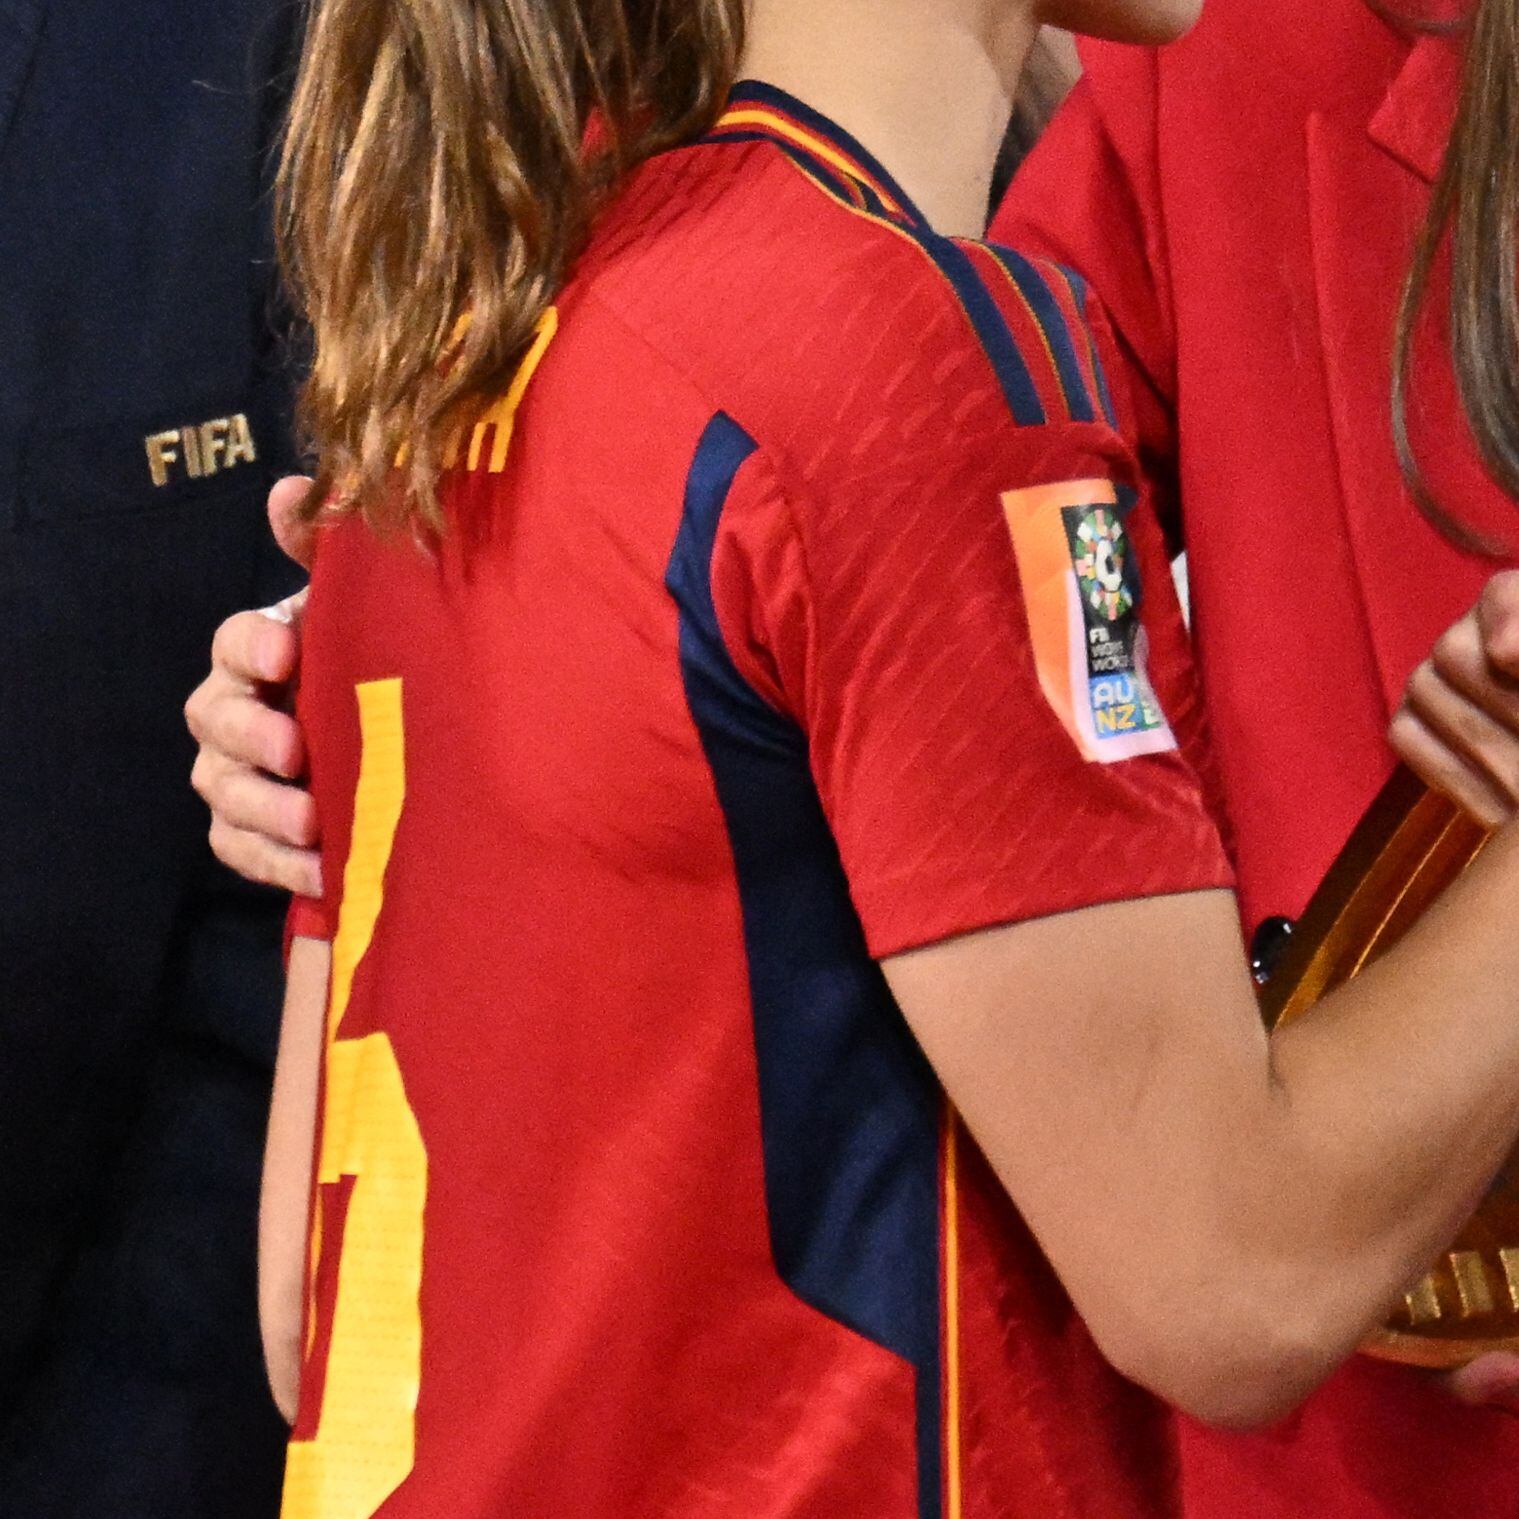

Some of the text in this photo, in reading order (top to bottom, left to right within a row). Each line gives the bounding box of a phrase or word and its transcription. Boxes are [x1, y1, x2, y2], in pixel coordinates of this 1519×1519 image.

[145, 413, 256, 487] FIFA
[1093, 677, 1134, 709] AU
[1096, 703, 1136, 733] NZ
